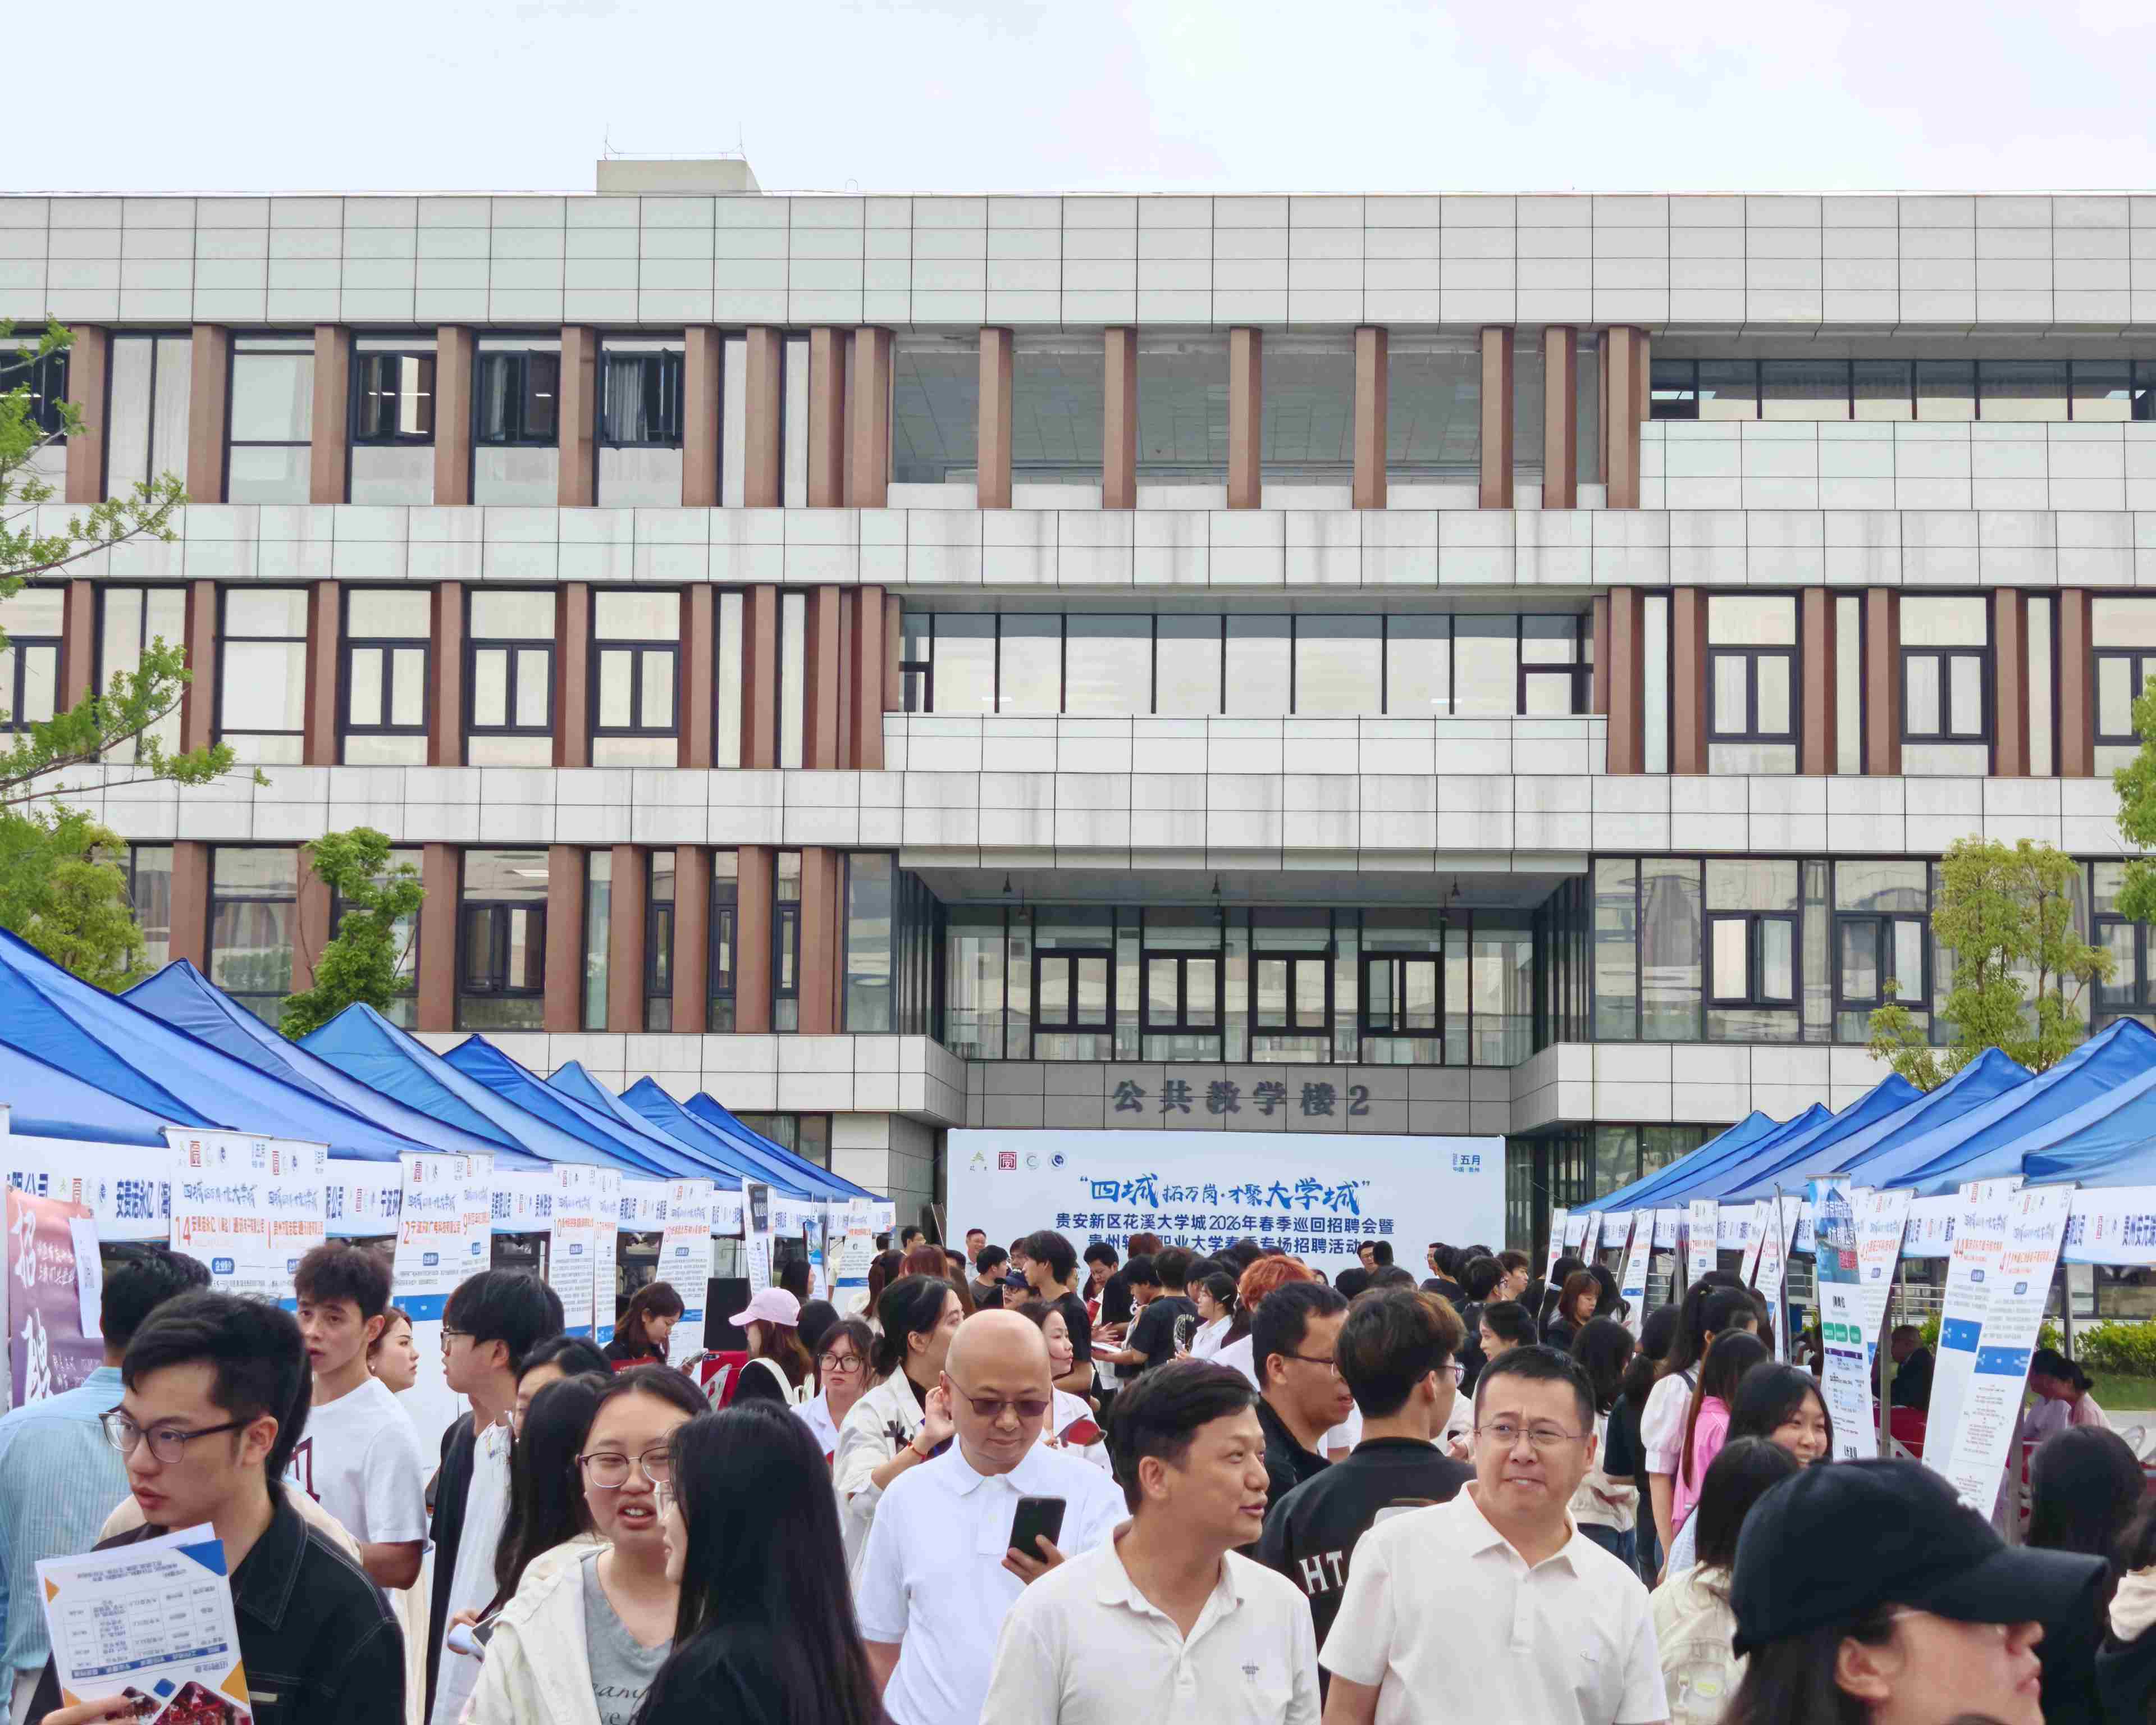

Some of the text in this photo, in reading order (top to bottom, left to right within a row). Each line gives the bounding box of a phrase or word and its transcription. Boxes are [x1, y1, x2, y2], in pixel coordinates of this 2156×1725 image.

[1112, 1079, 1369, 1116] 公共教学楼2
[1460, 1154, 1480, 1166] 五月
[175, 1215, 191, 1247] 14
[1056, 1212, 1395, 1235] 贵安新区花溪大学城2026年春季巡回招聘会暨
